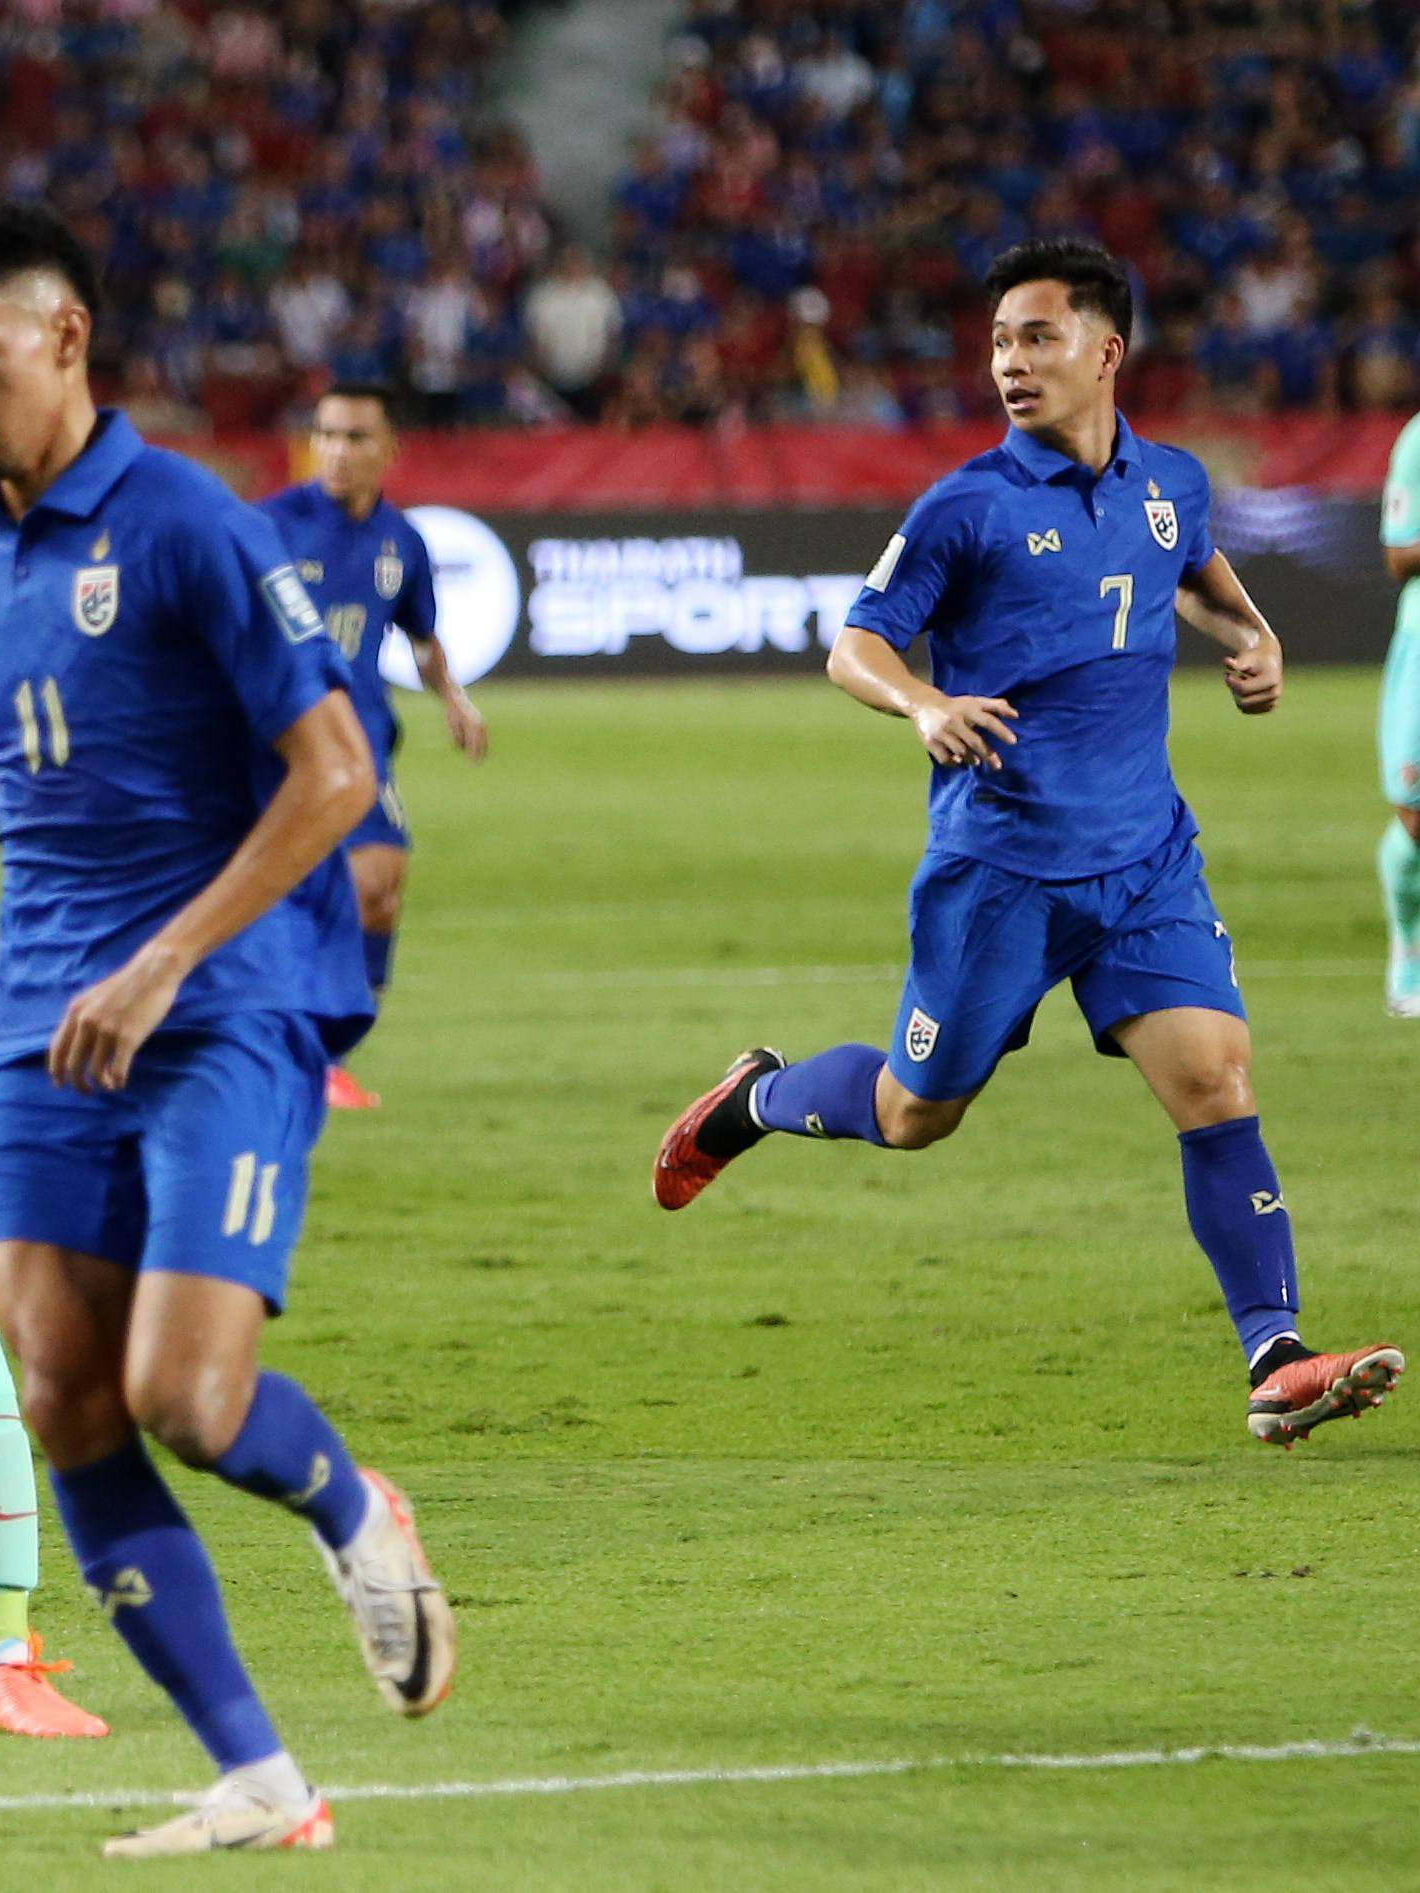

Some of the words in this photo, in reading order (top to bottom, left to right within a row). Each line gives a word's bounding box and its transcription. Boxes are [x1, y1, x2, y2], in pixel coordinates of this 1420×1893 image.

[1099, 573, 1134, 650] 7
[15, 676, 70, 774] 11
[221, 1151, 280, 1247] 11
